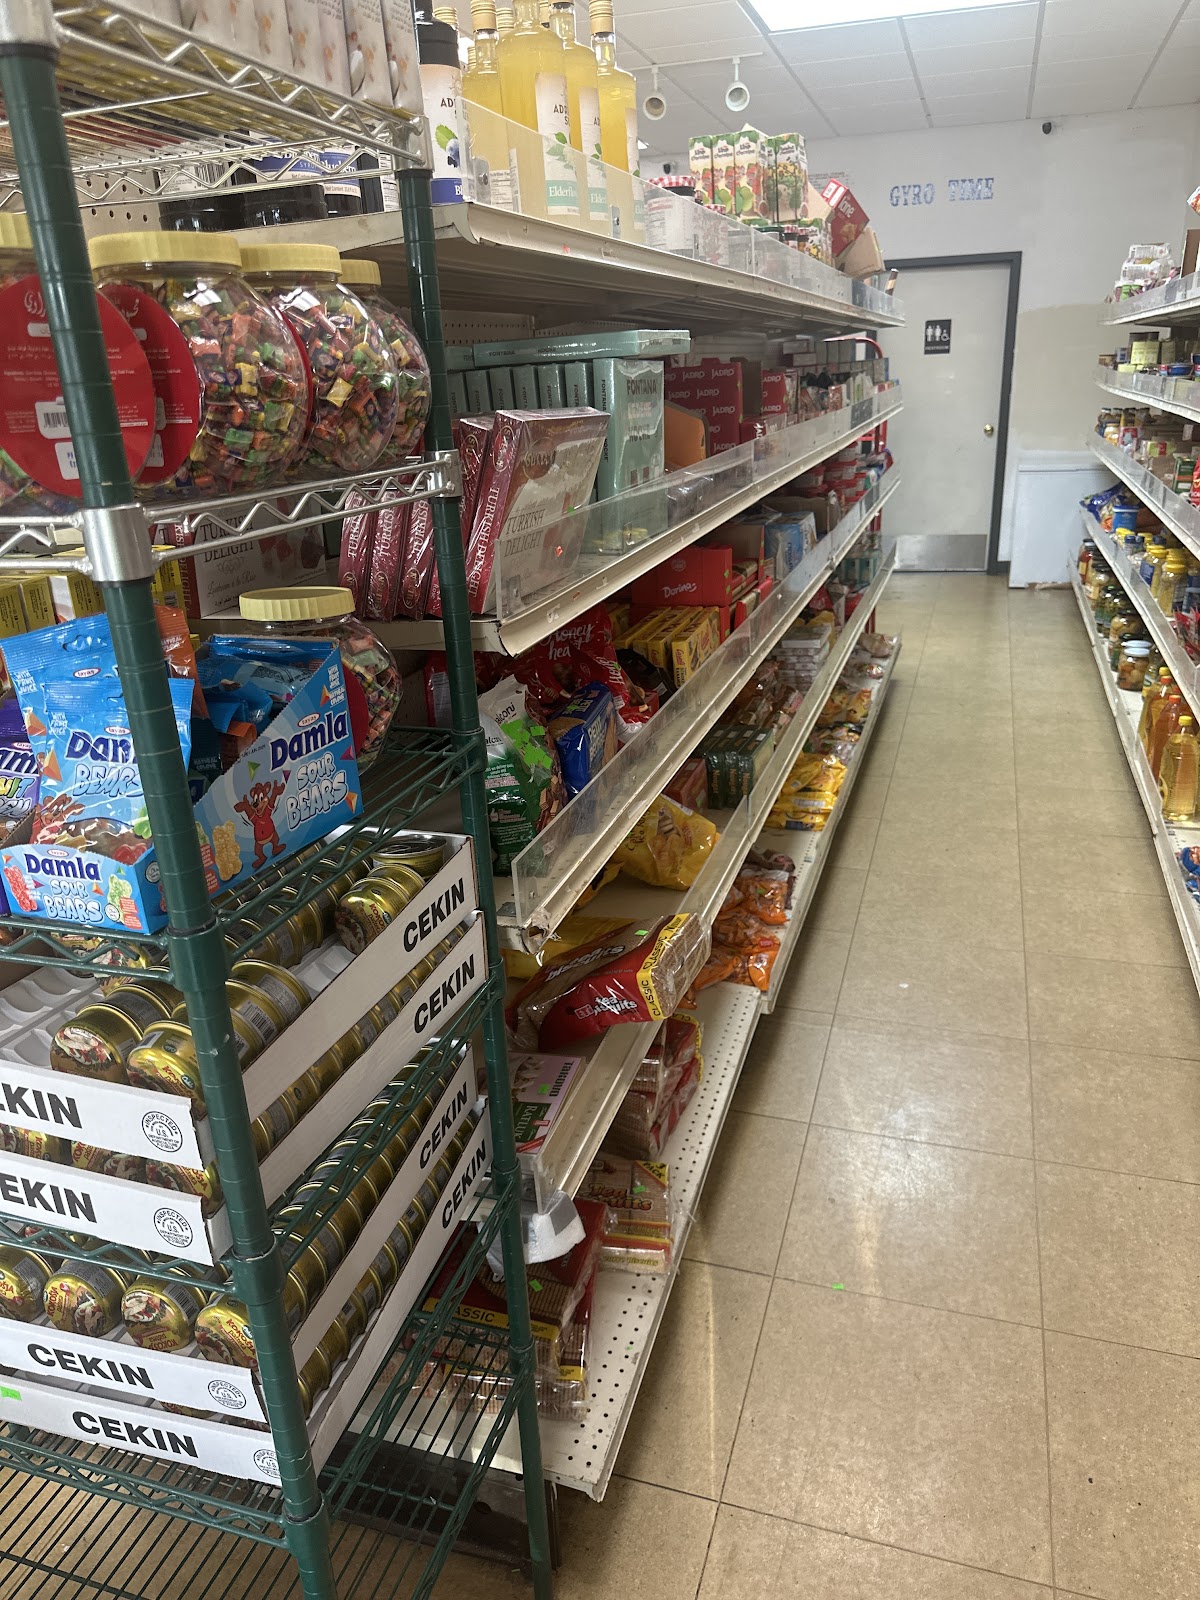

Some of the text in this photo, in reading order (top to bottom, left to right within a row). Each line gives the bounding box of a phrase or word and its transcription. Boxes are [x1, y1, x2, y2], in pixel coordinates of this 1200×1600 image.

[890, 178, 994, 207] GYRO TIME
[627, 379, 657, 395] FONTANA
[711, 369, 735, 379] JADRO
[696, 389, 719, 399] JADRO
[712, 406, 735, 415] JADRO
[505, 508, 545, 535] TURKISH
[504, 530, 544, 557] DELIGHT
[270, 711, 348, 771] Damla
[297, 752, 336, 789] SOUR
[286, 771, 348, 830] BEARS
[24, 854, 101, 881] Damla
[51, 880, 89, 898] SOUR
[43, 896, 103, 922] BEARS
[404, 877, 465, 952] CEKIN
[414, 953, 475, 1033] CEKIN
[642, 980, 661, 1016] CLASSIC
[145, 1113, 177, 1131] INSPECTED
[419, 1082, 468, 1169] CEKIN
[442, 1139, 486, 1229] CEKIN
[643, 1161, 665, 1178] PACK
[0, 1172, 97, 1224] EKIN
[26, 1343, 154, 1390] CEKIN
[72, 1411, 198, 1458] CEKIN
